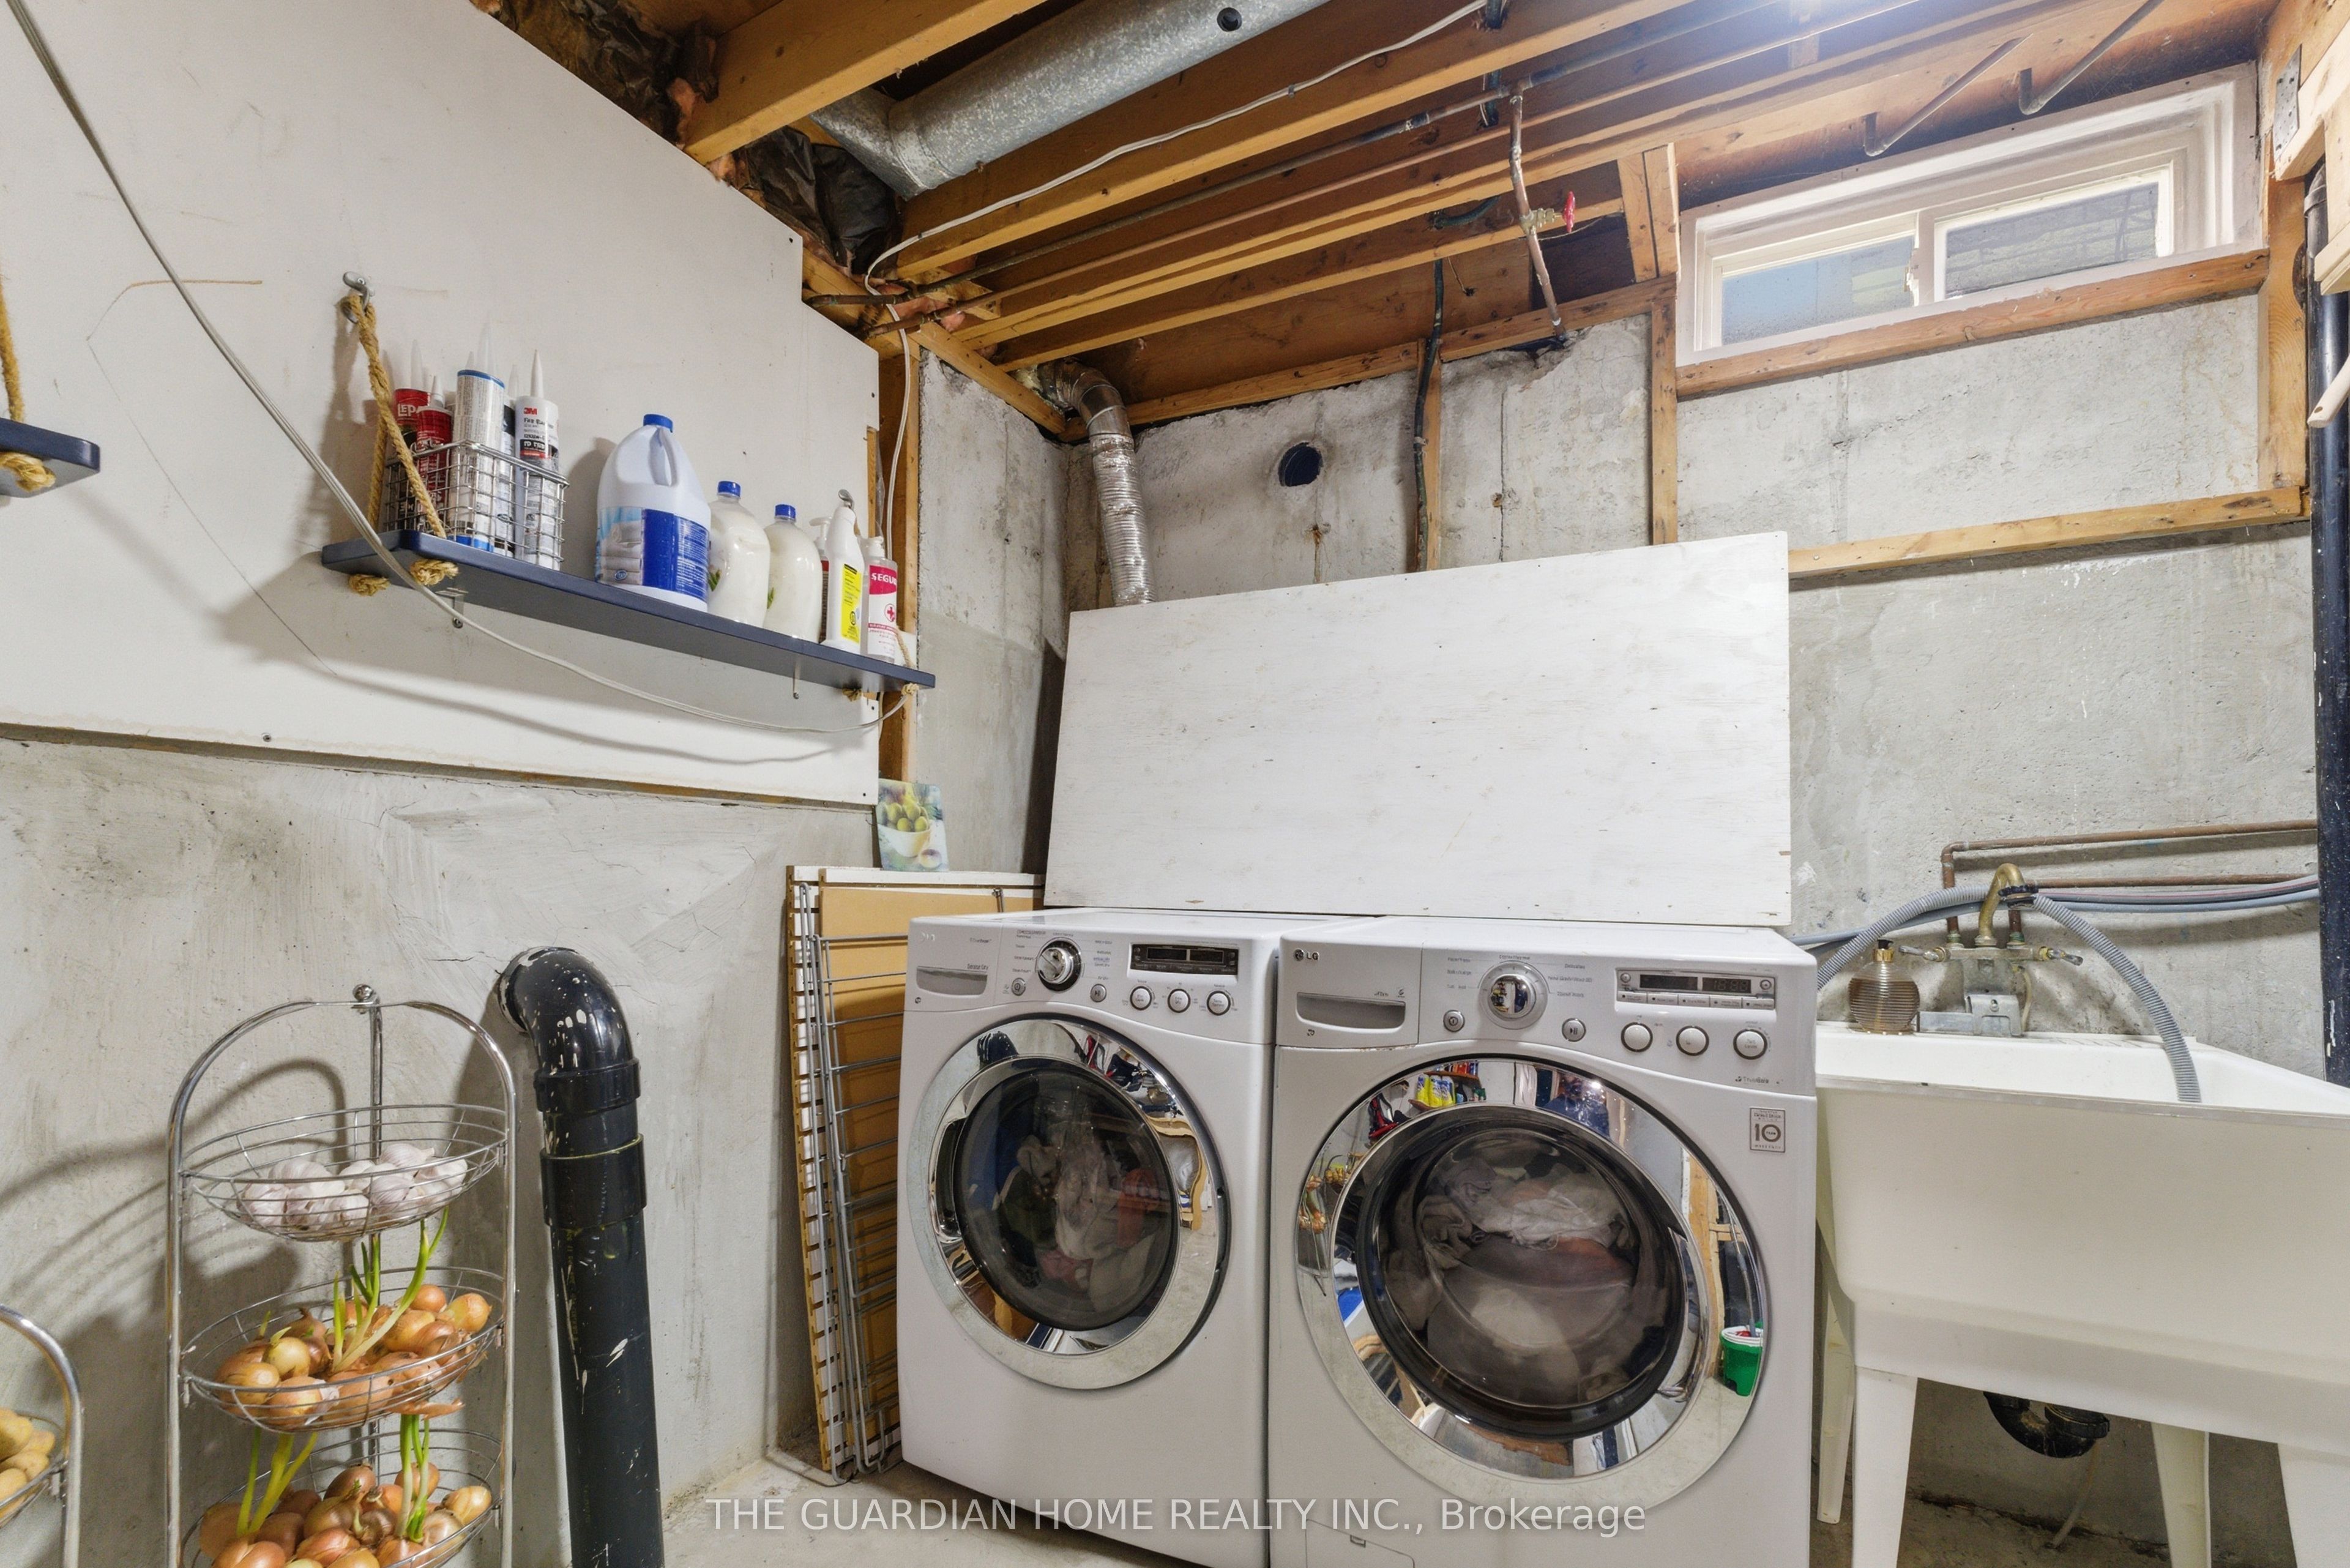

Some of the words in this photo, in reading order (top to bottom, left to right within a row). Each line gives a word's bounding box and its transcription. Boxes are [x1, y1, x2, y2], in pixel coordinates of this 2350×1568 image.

[397, 403, 418, 417] LEP
[1306, 951, 1319, 960] LG
[1755, 1123, 1781, 1143] 10
